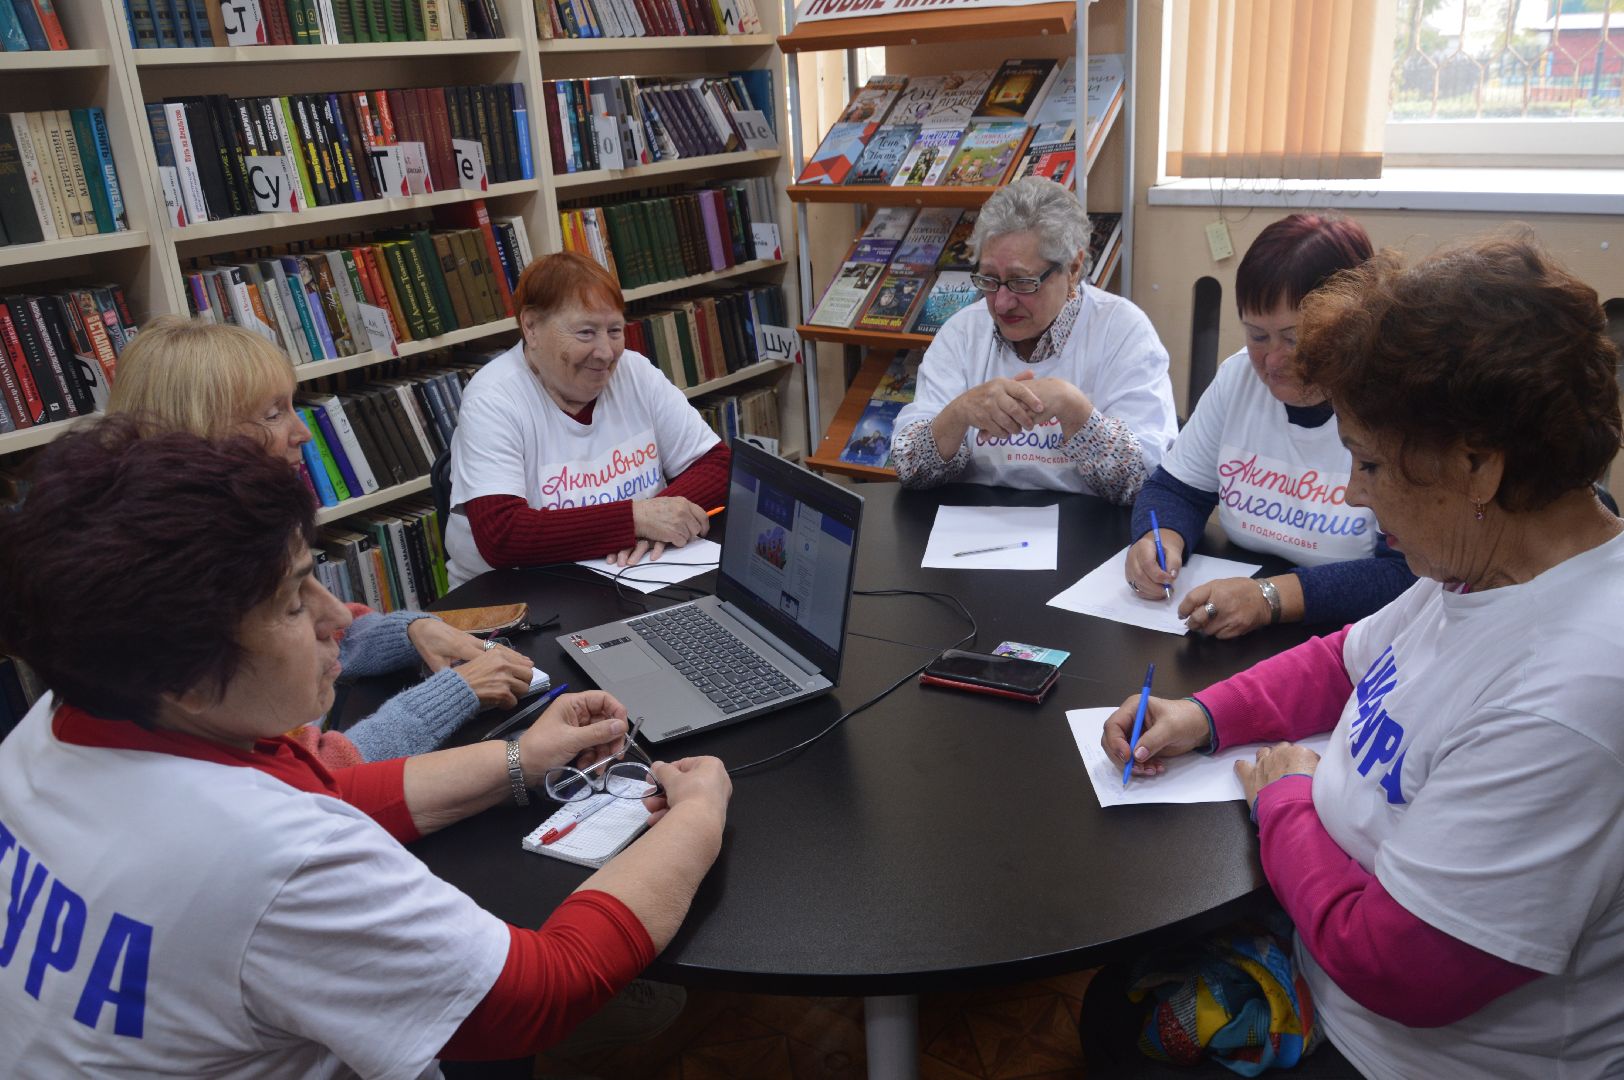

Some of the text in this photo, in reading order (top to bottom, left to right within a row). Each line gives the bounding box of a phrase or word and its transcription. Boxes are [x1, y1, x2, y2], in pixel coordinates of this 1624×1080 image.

[249, 165, 280, 208] Су
[763, 332, 792, 359] Шу
[542, 443, 657, 495] Активное
[1219, 454, 1347, 505] Активно
[1241, 521, 1319, 550] В ПОДМОСКОВЬЕ
